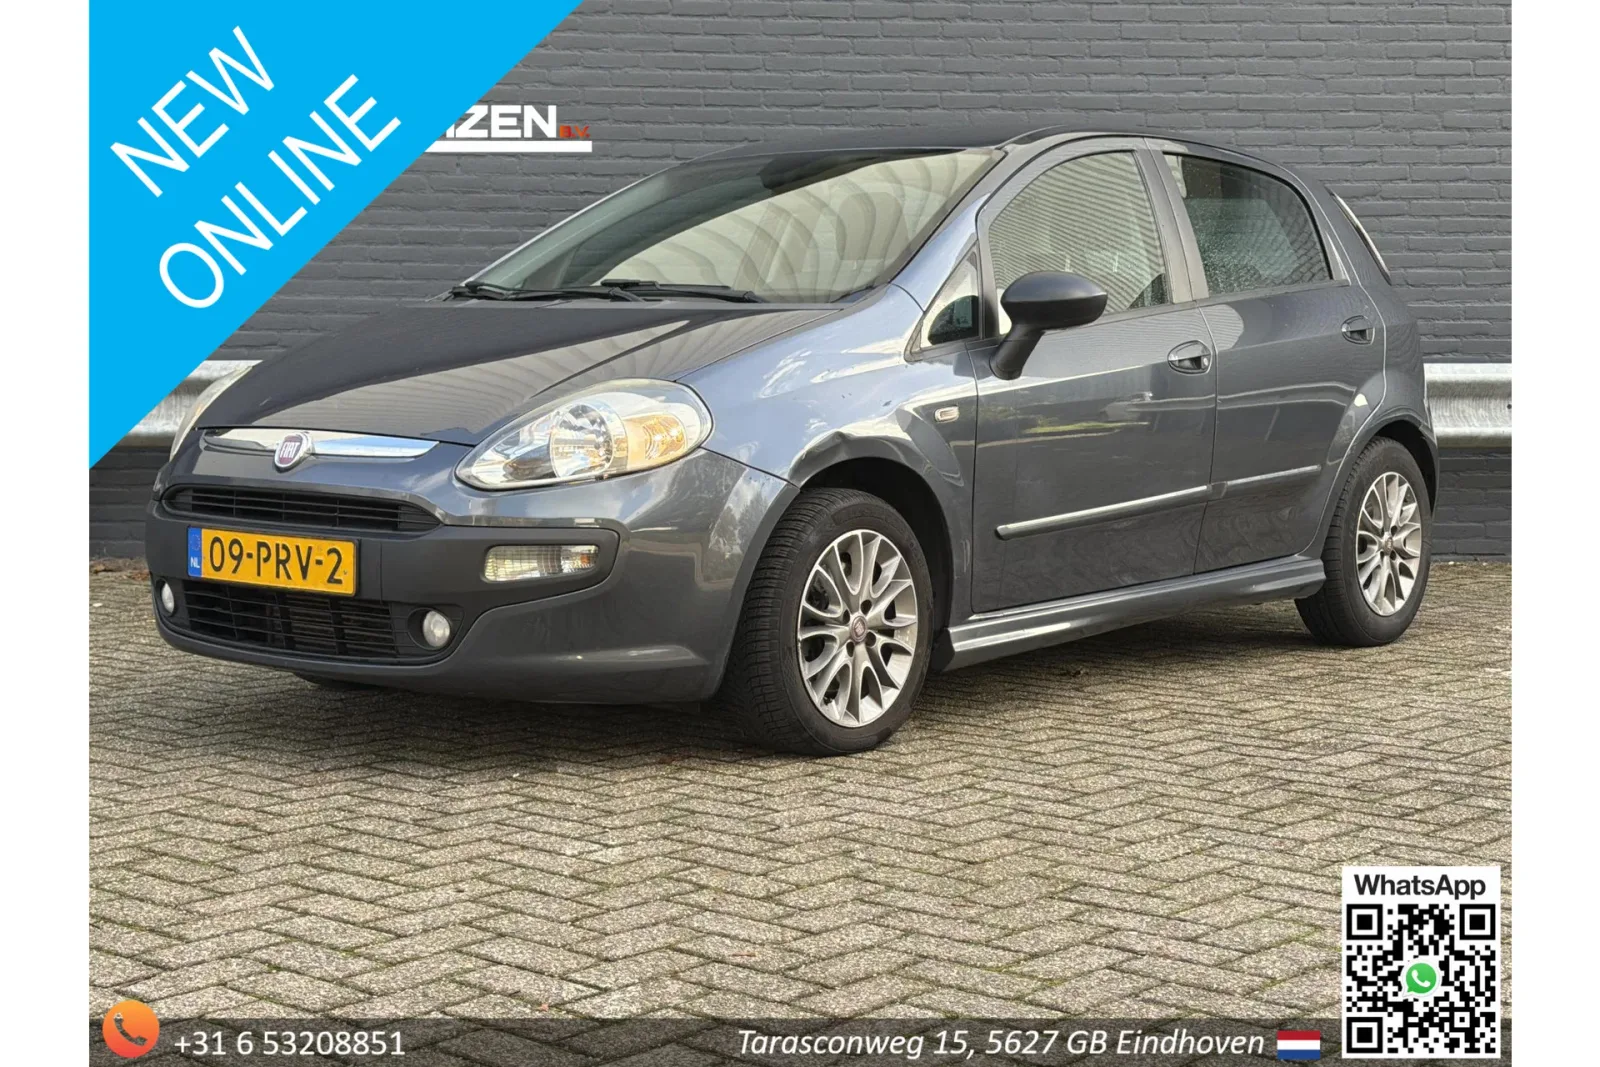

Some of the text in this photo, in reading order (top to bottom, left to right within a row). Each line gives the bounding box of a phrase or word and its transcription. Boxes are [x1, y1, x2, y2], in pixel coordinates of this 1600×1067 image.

[446, 105, 590, 138] ZEN B.V.
[279, 441, 300, 459] FIAT
[190, 556, 201, 569] NL
[209, 536, 343, 585] 09-PRV-2
